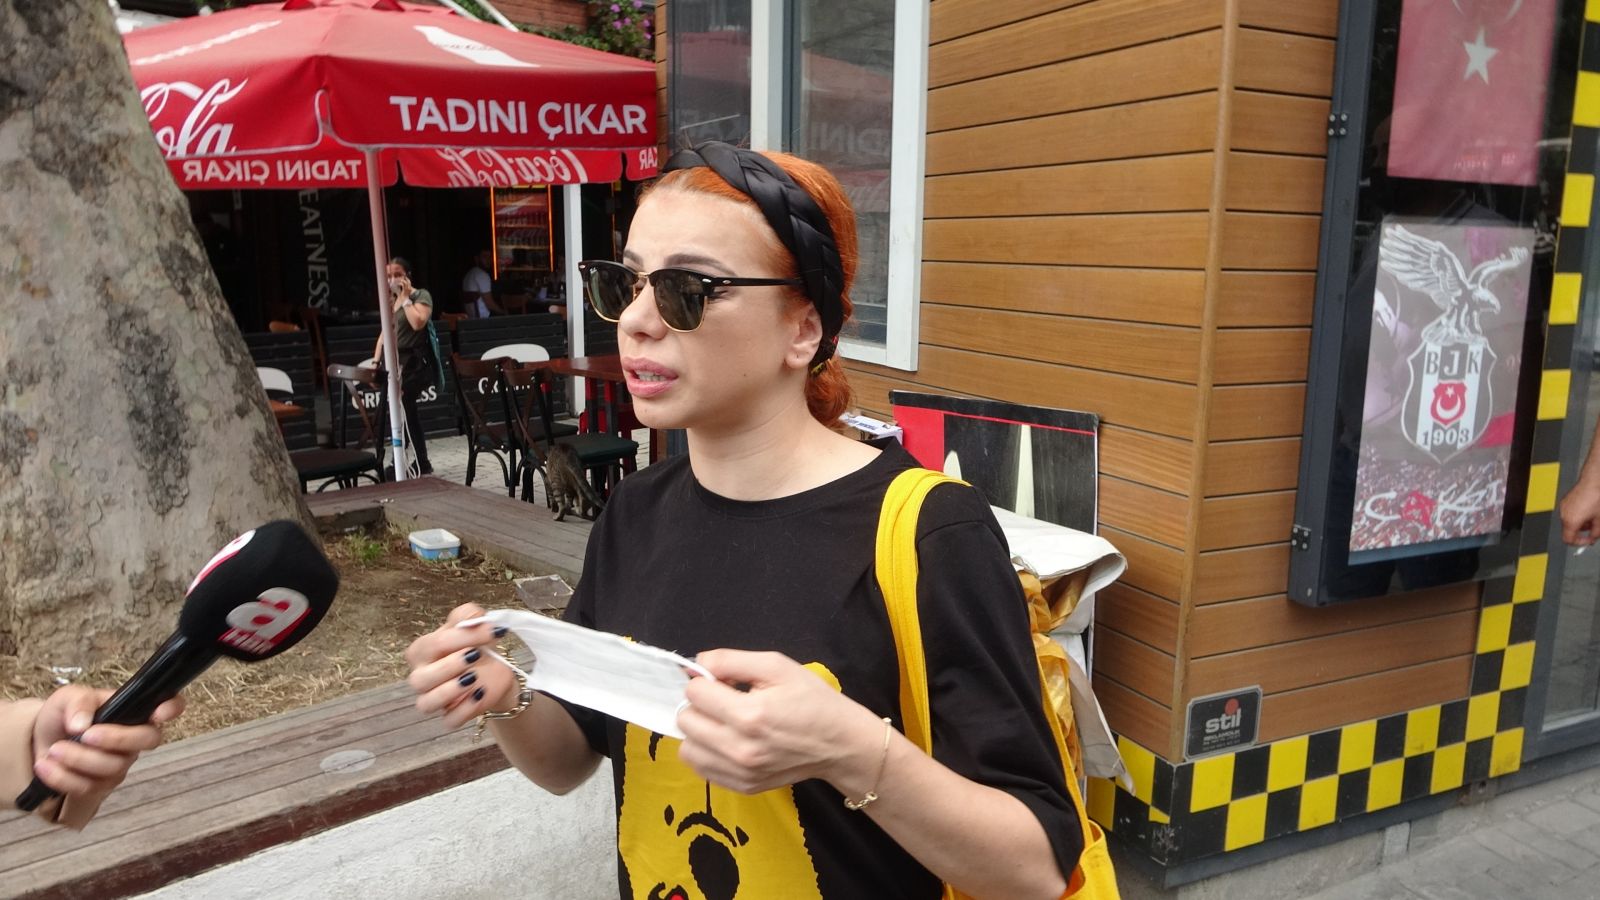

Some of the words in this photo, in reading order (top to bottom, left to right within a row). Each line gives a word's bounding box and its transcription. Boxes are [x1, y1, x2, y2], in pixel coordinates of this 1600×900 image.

[389, 95, 528, 134] TADINI
[537, 101, 648, 141] ÇIKAR
[298, 188, 330, 309] EATNESS
[1421, 428, 1470, 447] 1903
